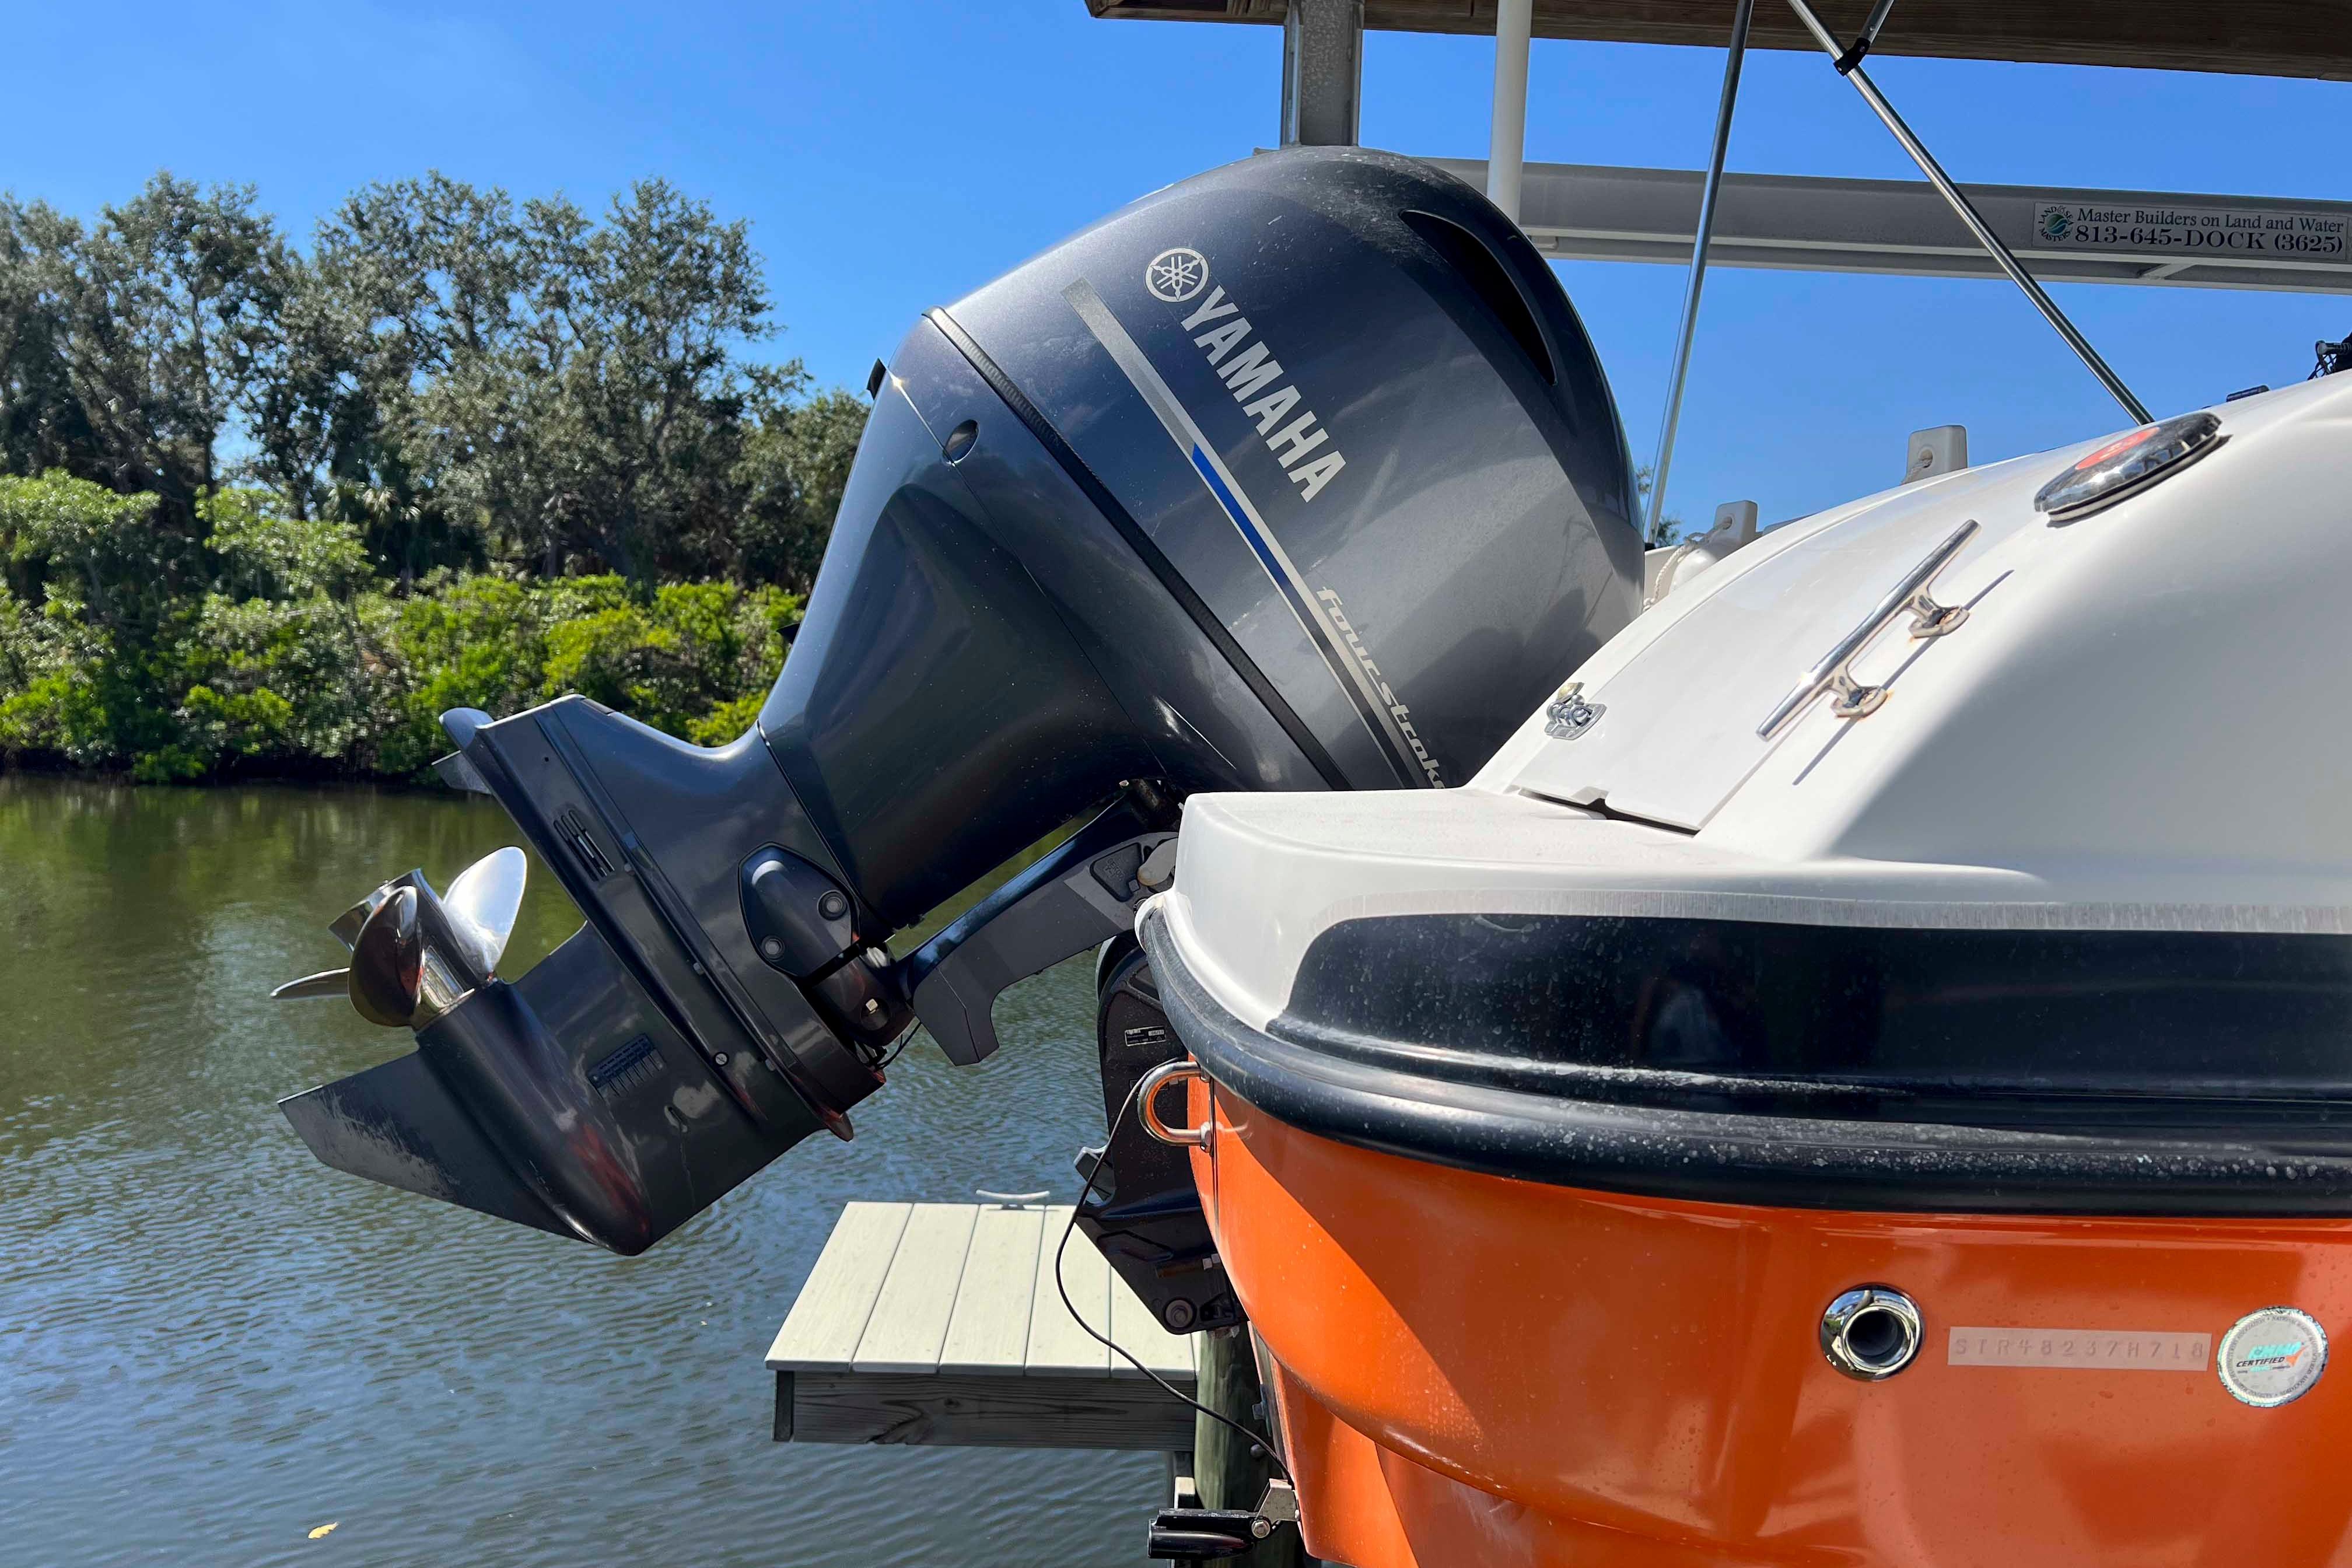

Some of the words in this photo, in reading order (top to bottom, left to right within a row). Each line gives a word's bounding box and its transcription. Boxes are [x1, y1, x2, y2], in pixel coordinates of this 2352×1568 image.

[2077, 208, 2130, 223] Master
[2135, 210, 2197, 226] Builders
[2202, 216, 2220, 227] on
[2225, 214, 2262, 229] Land
[2266, 217, 2294, 230] and
[2299, 218, 2344, 232] Water
[2075, 225, 2266, 249] 813-645-DOCK
[2274, 233, 2343, 253] (3625)
[1180, 285, 1346, 503] YAMAHA
[1316, 586, 1381, 676] four
[2236, 1356, 2286, 1368] CERTIFIED
